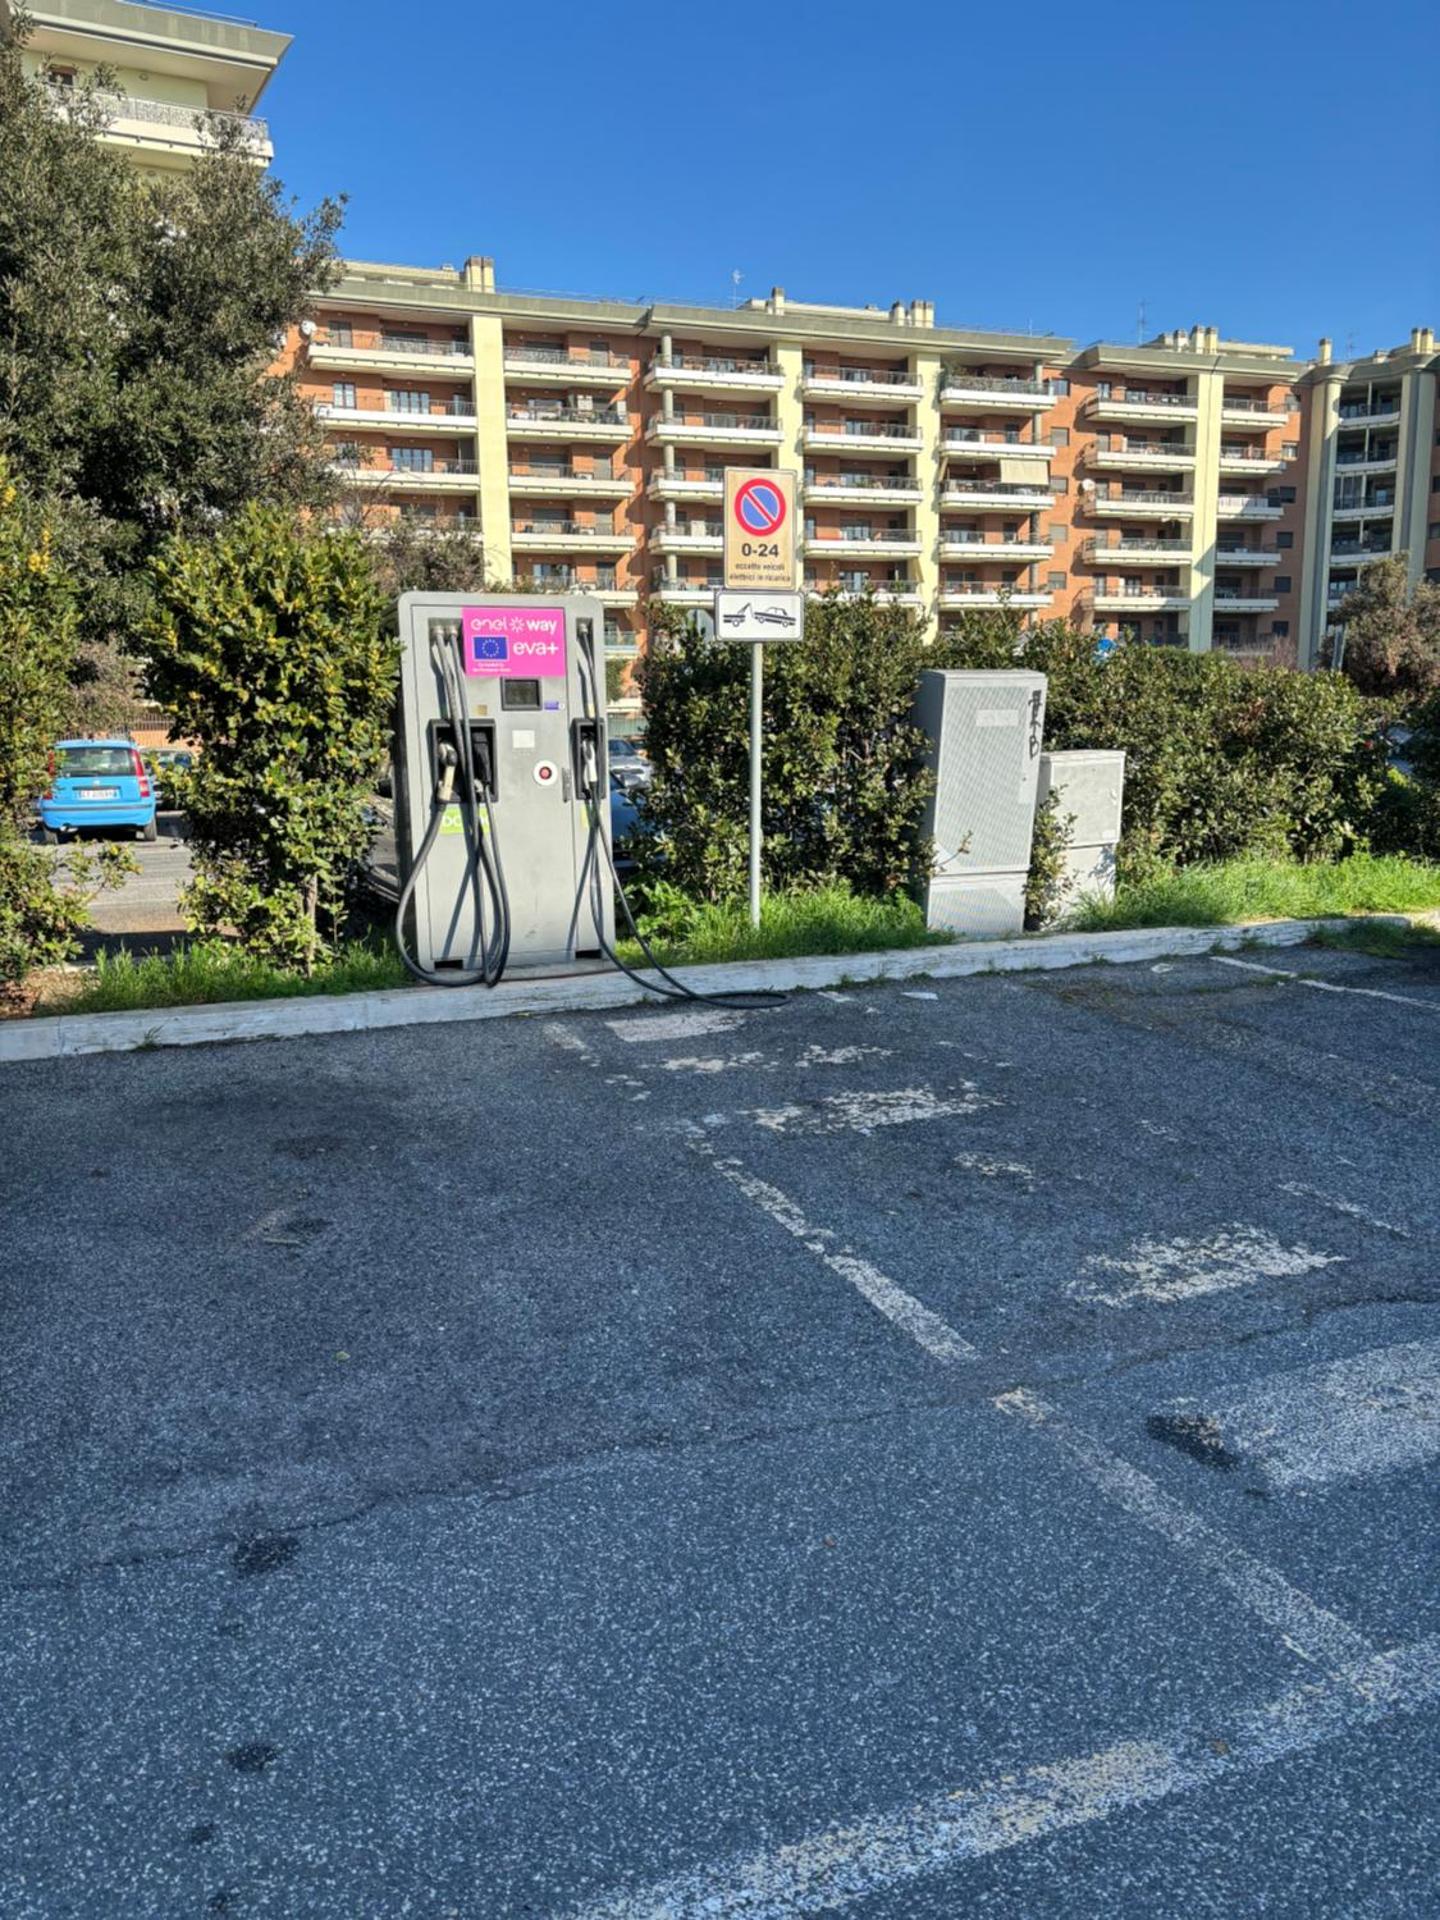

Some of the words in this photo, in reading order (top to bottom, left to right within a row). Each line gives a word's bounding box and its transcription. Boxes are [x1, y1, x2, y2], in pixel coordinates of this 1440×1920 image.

[741, 542, 779, 557] 0-24
[470, 616, 508, 631] enel
[526, 618, 557, 635] way
[512, 641, 559, 656] eva+
